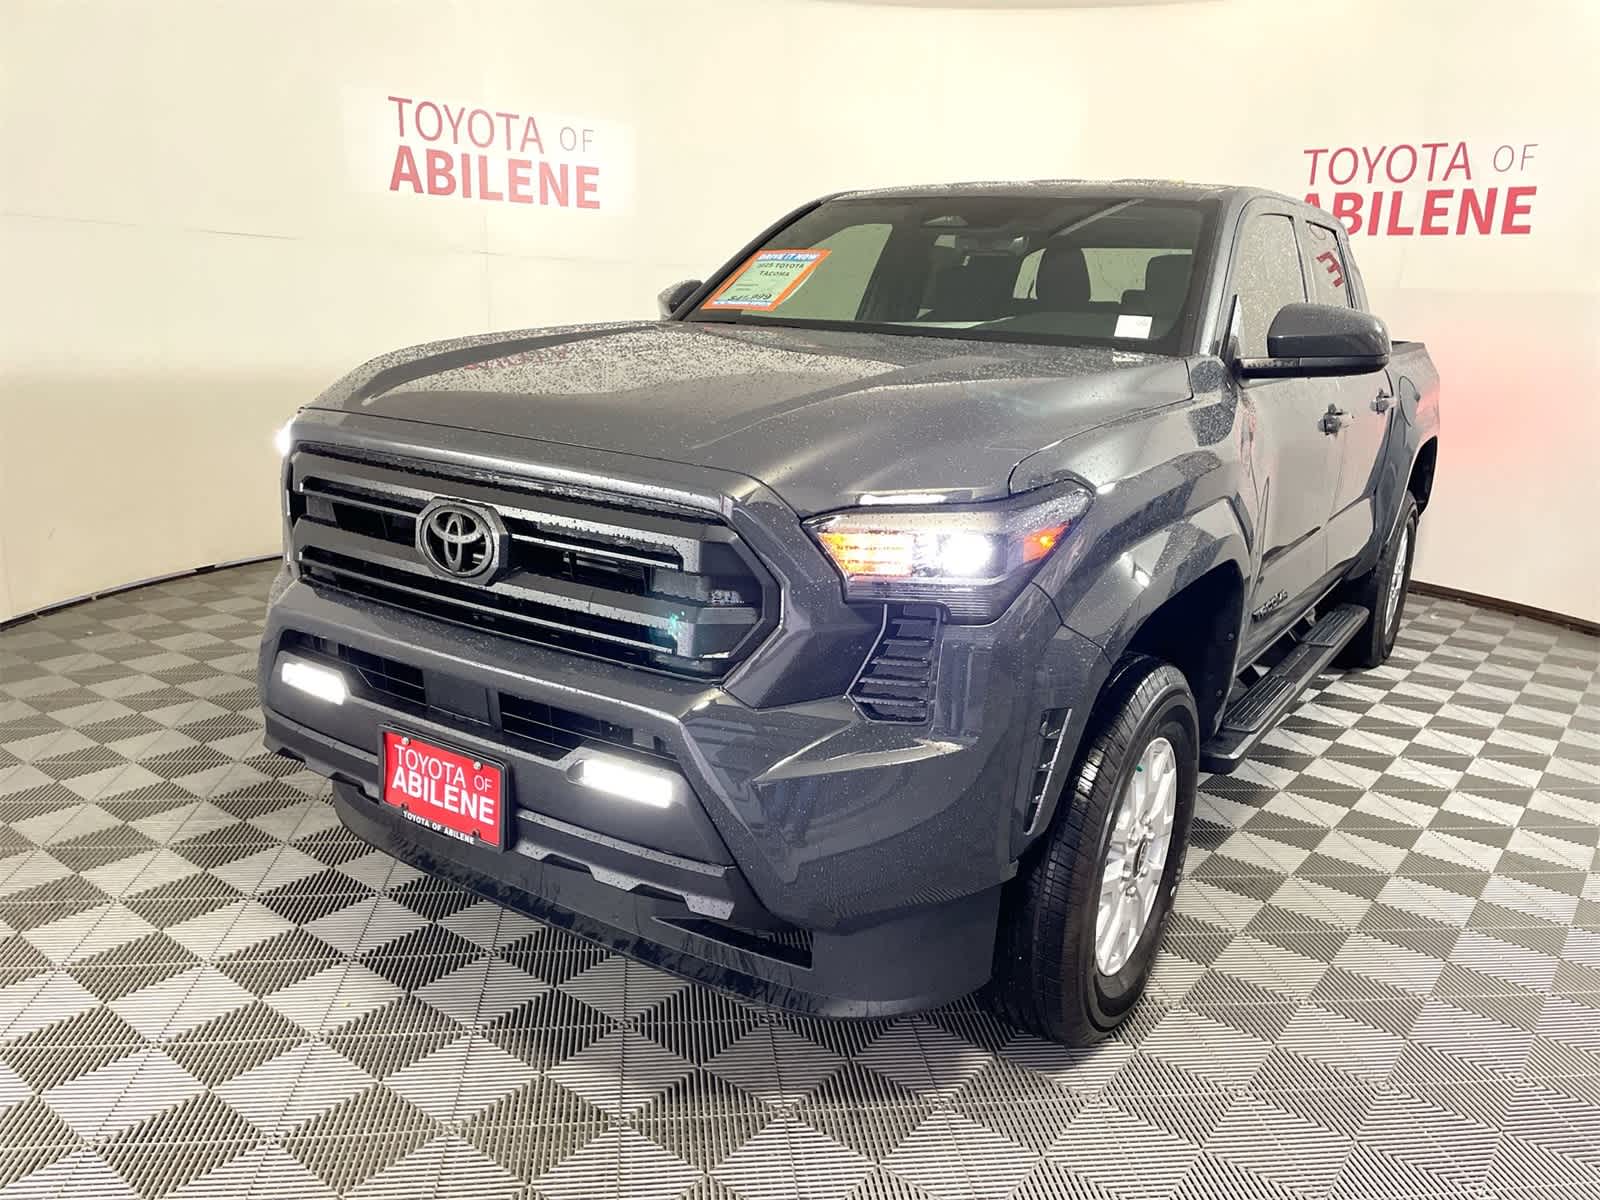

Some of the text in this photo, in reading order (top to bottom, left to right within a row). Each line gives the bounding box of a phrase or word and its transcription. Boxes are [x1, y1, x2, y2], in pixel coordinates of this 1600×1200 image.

[388, 96, 594, 154] TOYOTA OF
[389, 145, 601, 209] ABILENE
[1303, 141, 1538, 186] TOYOTA OF
[775, 262, 805, 270] TOYOTA
[394, 744, 493, 792] TOYOTA OF
[393, 766, 495, 825] ABILENE
[403, 810, 475, 844] TOYOTA OF ABILENE
